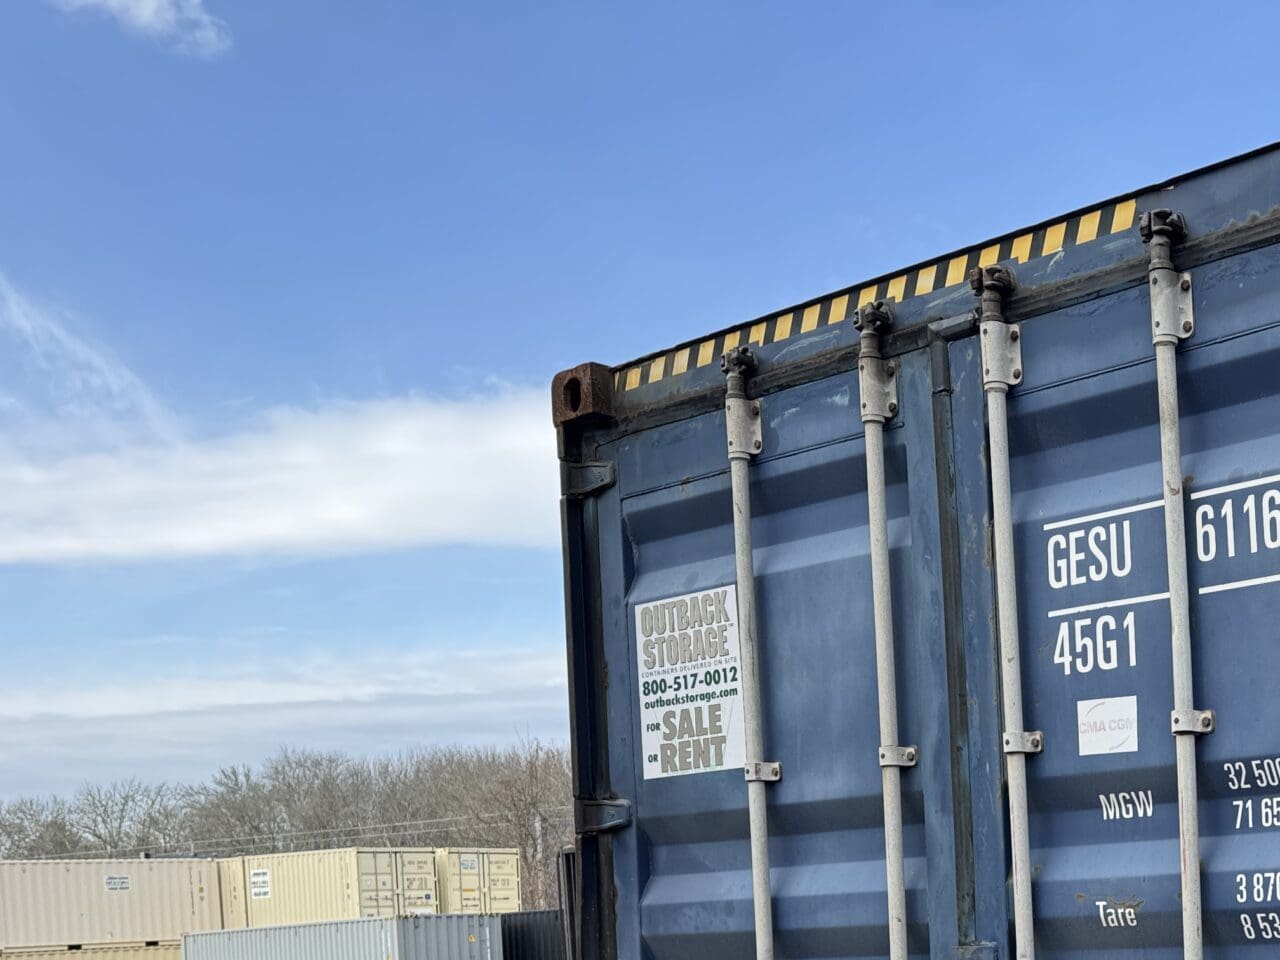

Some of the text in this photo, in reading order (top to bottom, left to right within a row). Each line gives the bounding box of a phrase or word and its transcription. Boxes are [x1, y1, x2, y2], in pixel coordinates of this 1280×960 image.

[1047, 519, 1132, 589] GESU
[640, 589, 730, 638] OUTBACK
[643, 625, 730, 670] STORAGE
[1053, 611, 1137, 675] 45G1
[642, 666, 738, 696] 800-517-0012
[644, 687, 738, 710] outbackstorage.com
[646, 704, 722, 741] FOR SALE
[1080, 720, 1106, 734] CMA
[648, 736, 726, 774] OR RENT
[1224, 761, 1251, 790] 32
[1099, 790, 1153, 820] MGW
[1233, 800, 1253, 829] 71
[1236, 874, 1248, 902] 3
[1096, 901, 1138, 927] Tare
[1240, 914, 1255, 940] 8
